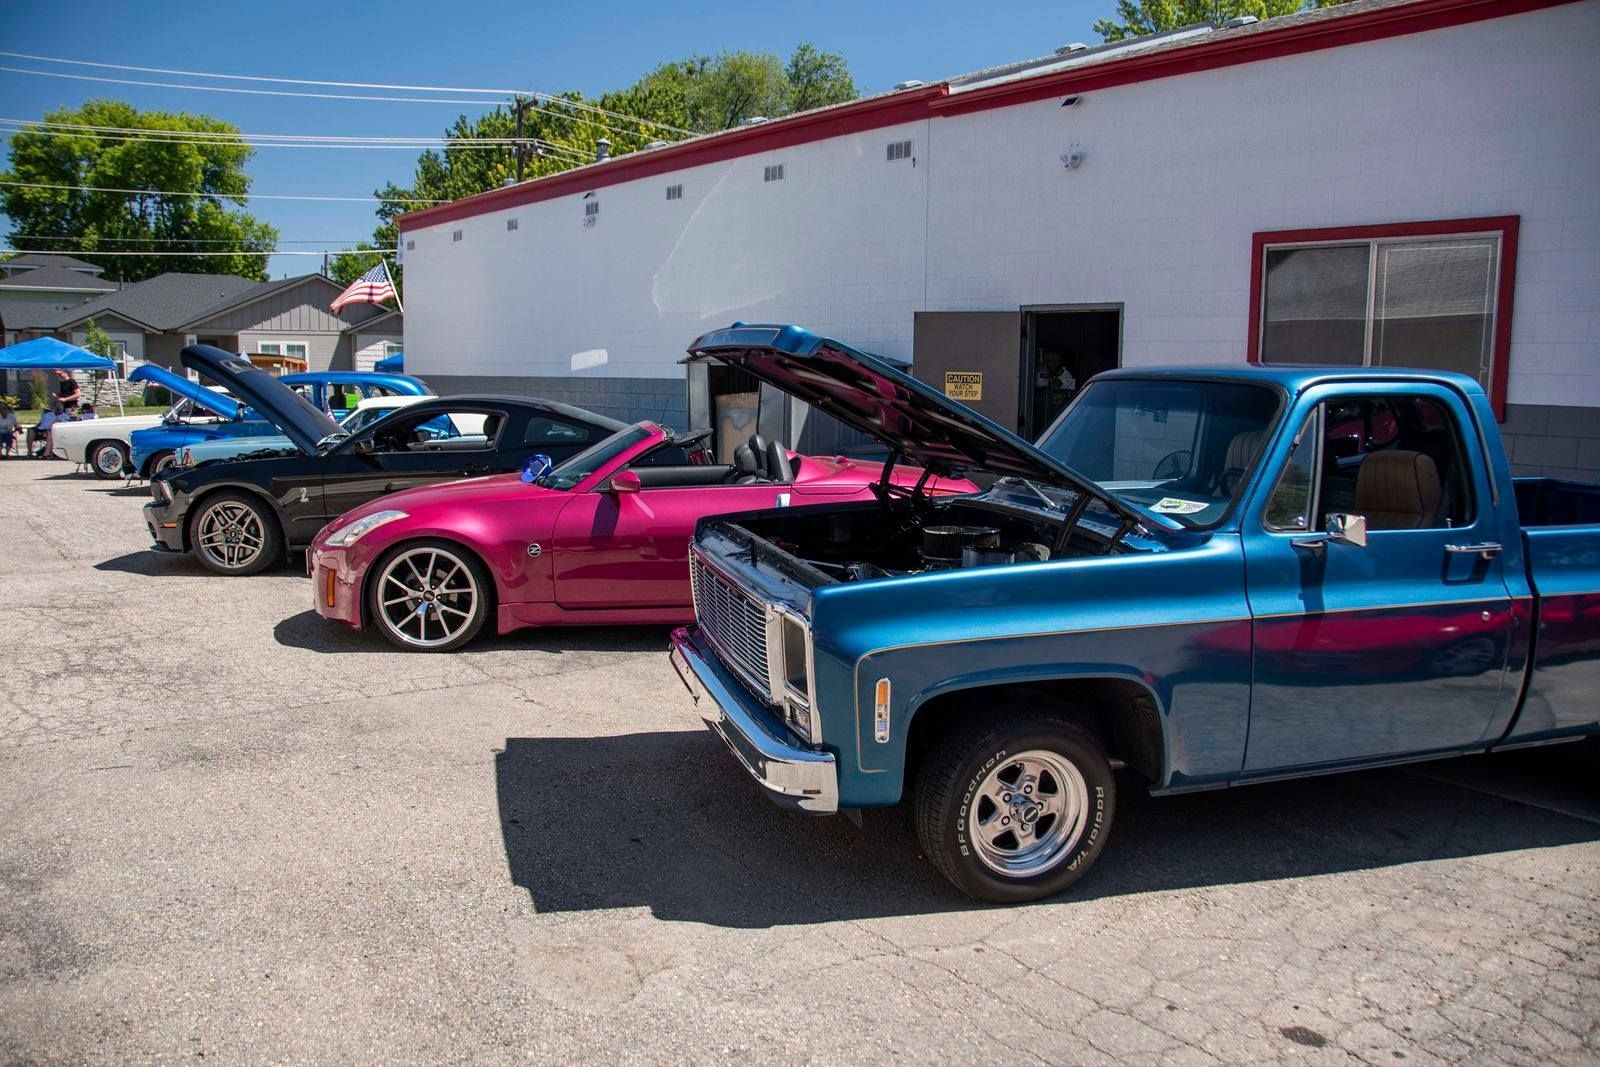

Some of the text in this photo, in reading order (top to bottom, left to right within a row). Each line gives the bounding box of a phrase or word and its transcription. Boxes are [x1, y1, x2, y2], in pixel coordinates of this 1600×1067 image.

[948, 375, 980, 383] CAUTION
[957, 750, 1006, 856] BFGoodrich
[1067, 786, 1105, 871] Radial T/A
